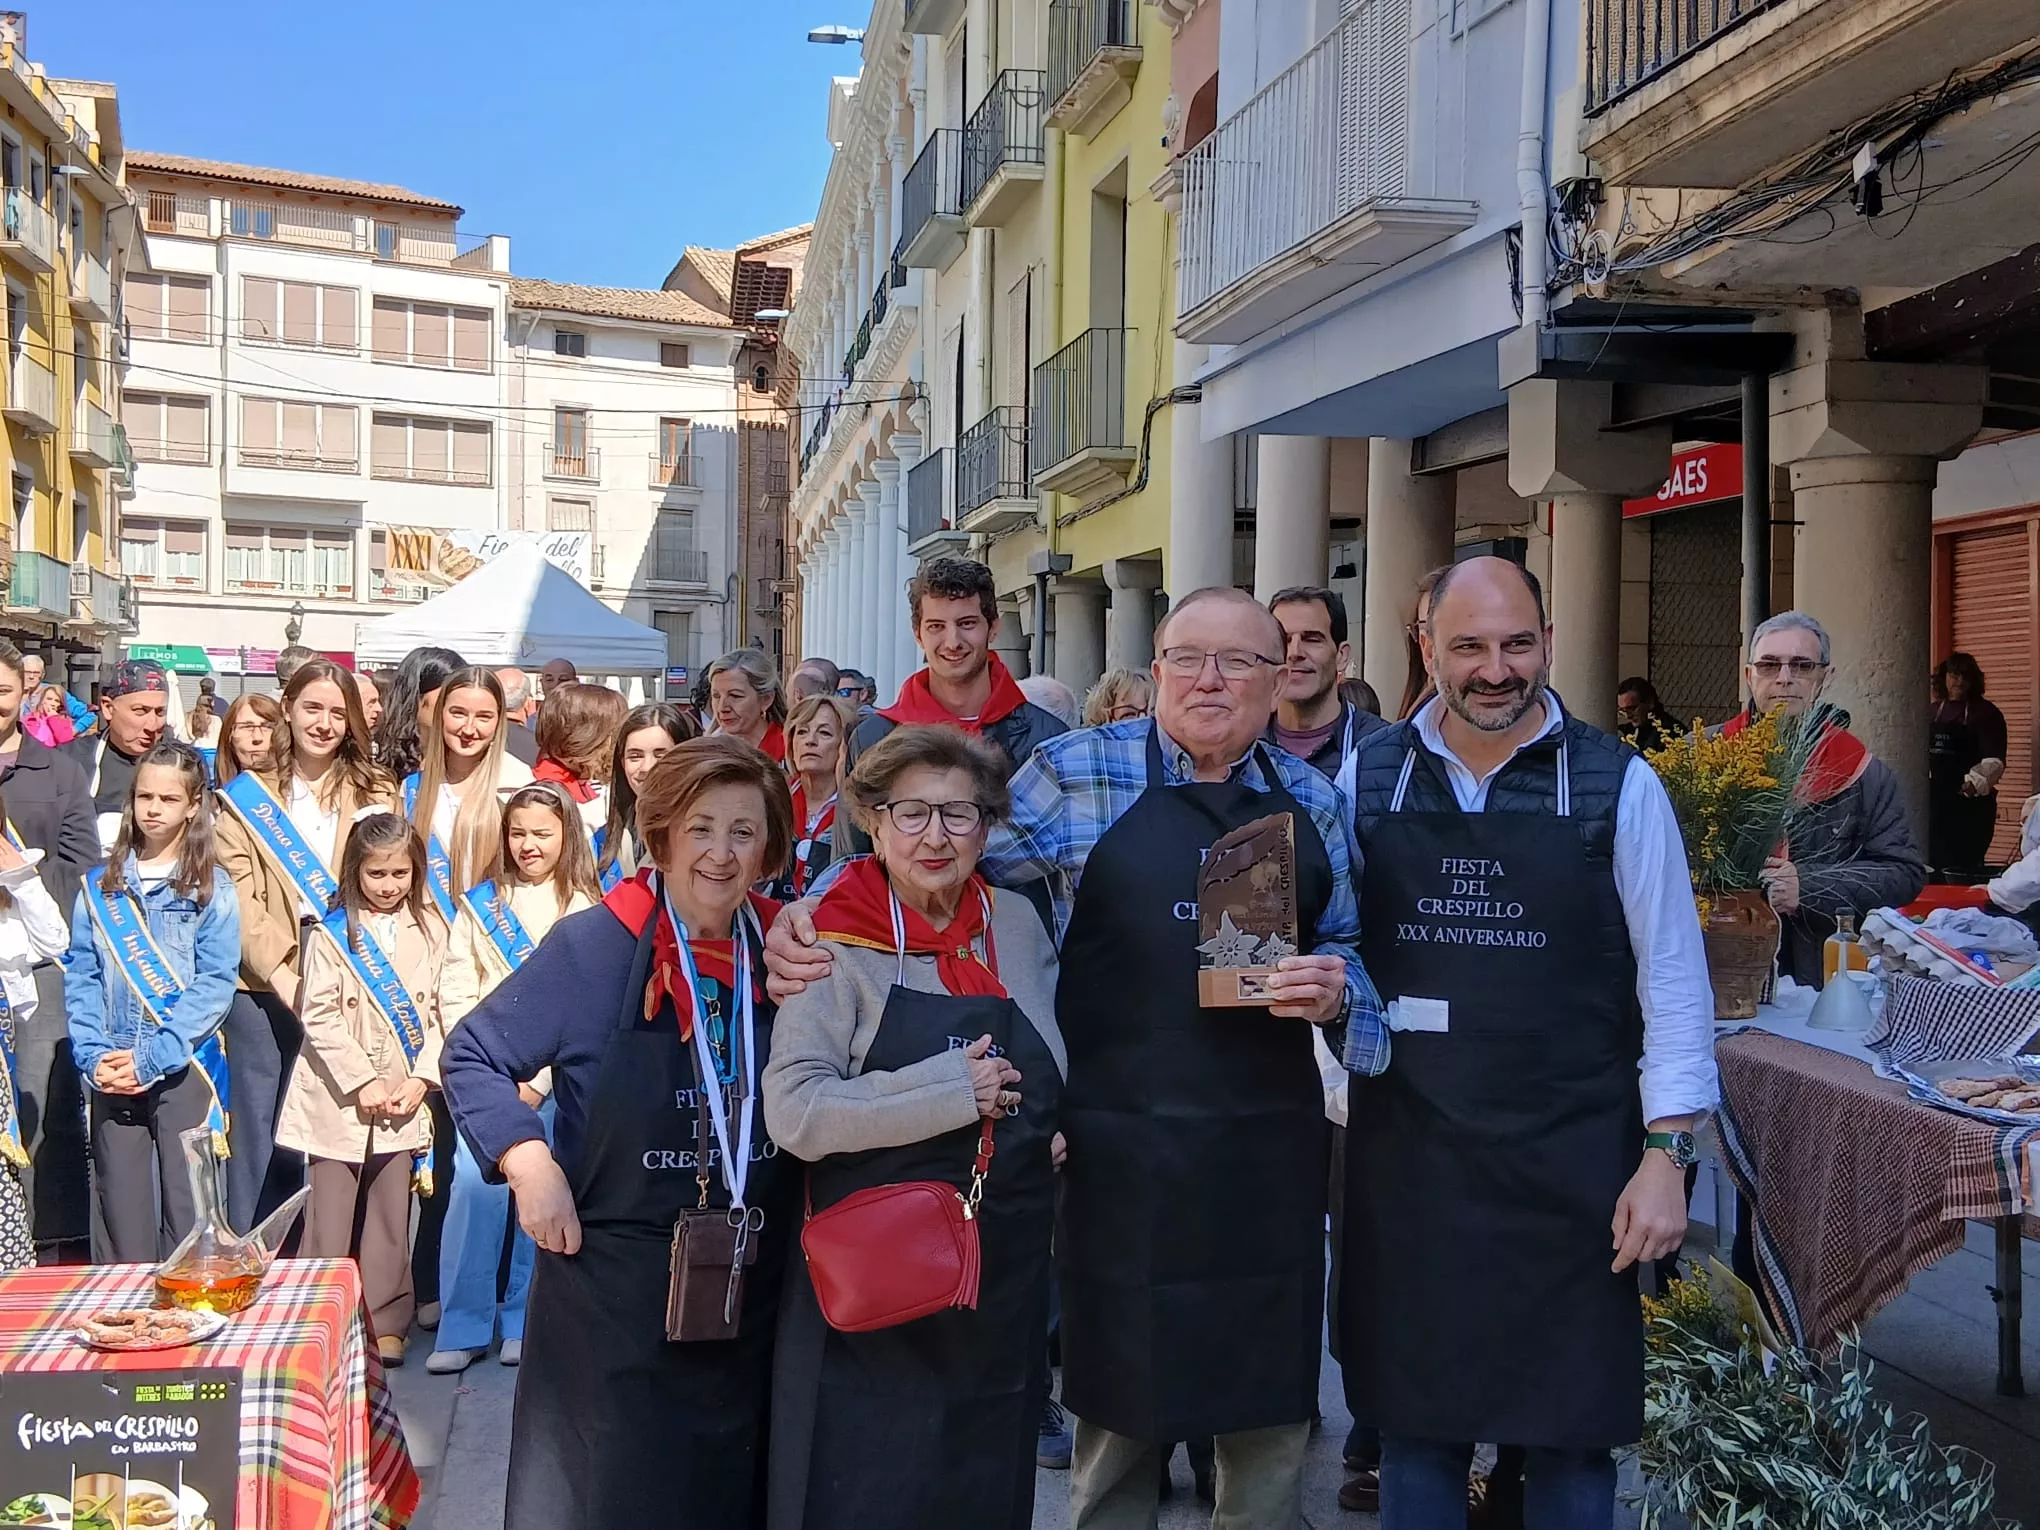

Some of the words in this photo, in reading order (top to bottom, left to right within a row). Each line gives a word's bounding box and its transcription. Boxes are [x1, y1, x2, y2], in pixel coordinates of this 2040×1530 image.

[388, 533, 432, 572] XXXI
[545, 537, 580, 558] del
[250, 802, 293, 848] Dama
[289, 850, 308, 870] de
[1440, 858, 1505, 877] FIESTA
[1451, 879, 1490, 896] DEL
[1417, 898, 1524, 919] CRESPILLO
[1397, 923, 1430, 942] XXX
[1433, 927, 1547, 948] ANIVERSARIO
[132, 1440, 197, 1454] BARBASTRO
